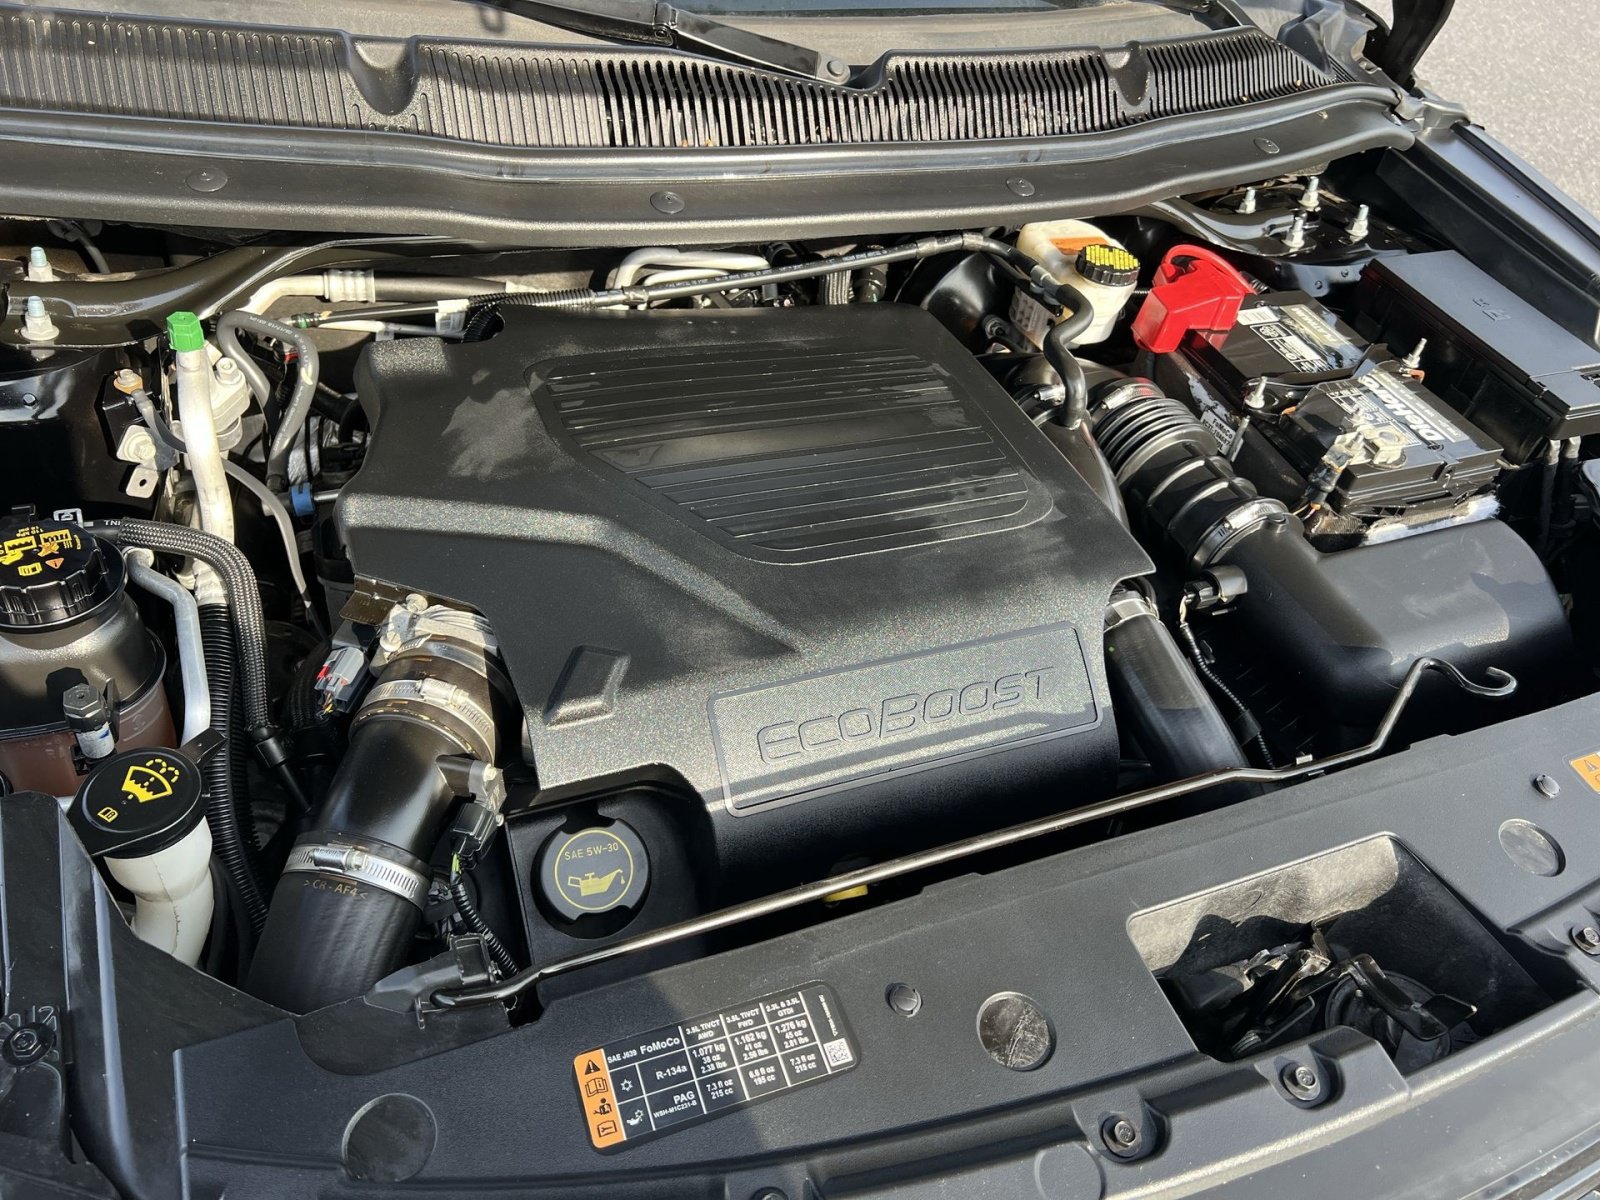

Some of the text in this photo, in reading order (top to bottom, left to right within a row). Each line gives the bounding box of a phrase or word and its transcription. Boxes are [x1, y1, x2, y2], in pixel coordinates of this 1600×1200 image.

[564, 842, 619, 861] SAE 5W-30
[738, 1019, 754, 1029] FWD
[775, 1018, 808, 1034] 1.276 kg
[698, 1030, 714, 1041] AWD
[756, 1030, 767, 1042] kg
[784, 1029, 803, 1040] 45 oz
[753, 1041, 762, 1049] oz
[797, 1036, 809, 1047] lbs
[607, 1037, 681, 1064] SAE J639 FoMoCo
[692, 1042, 726, 1059] 1.077 kg
[756, 1048, 769, 1058] lbs
[701, 1054, 721, 1064] 38 oz
[790, 1057, 801, 1067] 7.3
[807, 1053, 816, 1061] oz
[655, 1064, 688, 1080] R-134a
[700, 1060, 727, 1074] 2.38 lbs
[765, 1065, 775, 1073] oz
[795, 1062, 817, 1074] 215 cc
[706, 1082, 717, 1092] 7.3
[724, 1079, 734, 1087] oz
[753, 1074, 776, 1086] 195 cc
[673, 1090, 696, 1104] PAG
[710, 1087, 734, 1100] 215 cc
